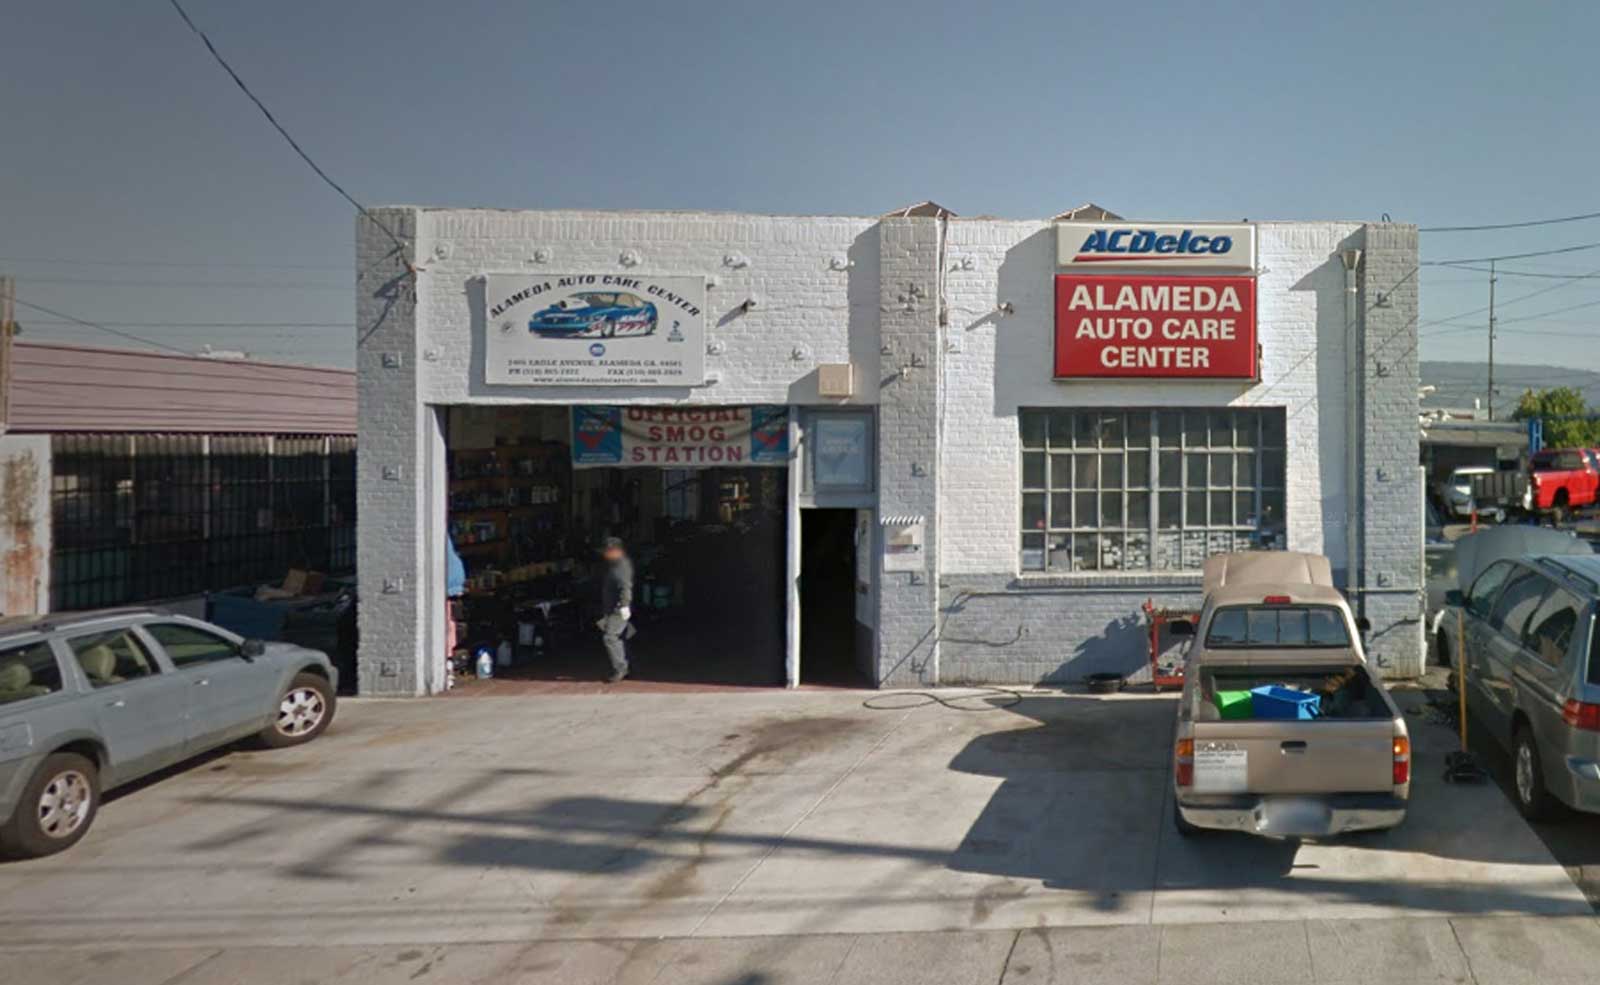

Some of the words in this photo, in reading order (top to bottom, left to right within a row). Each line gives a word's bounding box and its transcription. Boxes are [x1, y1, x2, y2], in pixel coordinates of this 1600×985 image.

[1078, 229, 1233, 254] ACDelco
[490, 281, 552, 319] ALAMEDA
[557, 275, 596, 287] AUTO
[602, 275, 642, 290] CARE
[647, 284, 701, 317] CENTER
[1068, 284, 1242, 312] ALAMEDA
[1075, 318, 1153, 340] AUTO
[1161, 318, 1236, 340] CARE
[528, 359, 557, 367] EAGLE
[599, 359, 641, 367] ALAMEDA
[1100, 346, 1210, 368] CENTER
[607, 368, 625, 376] FAX
[627, 406, 745, 421] OFFICIAL
[650, 426, 726, 442] SMOG
[631, 446, 743, 462] STATION
